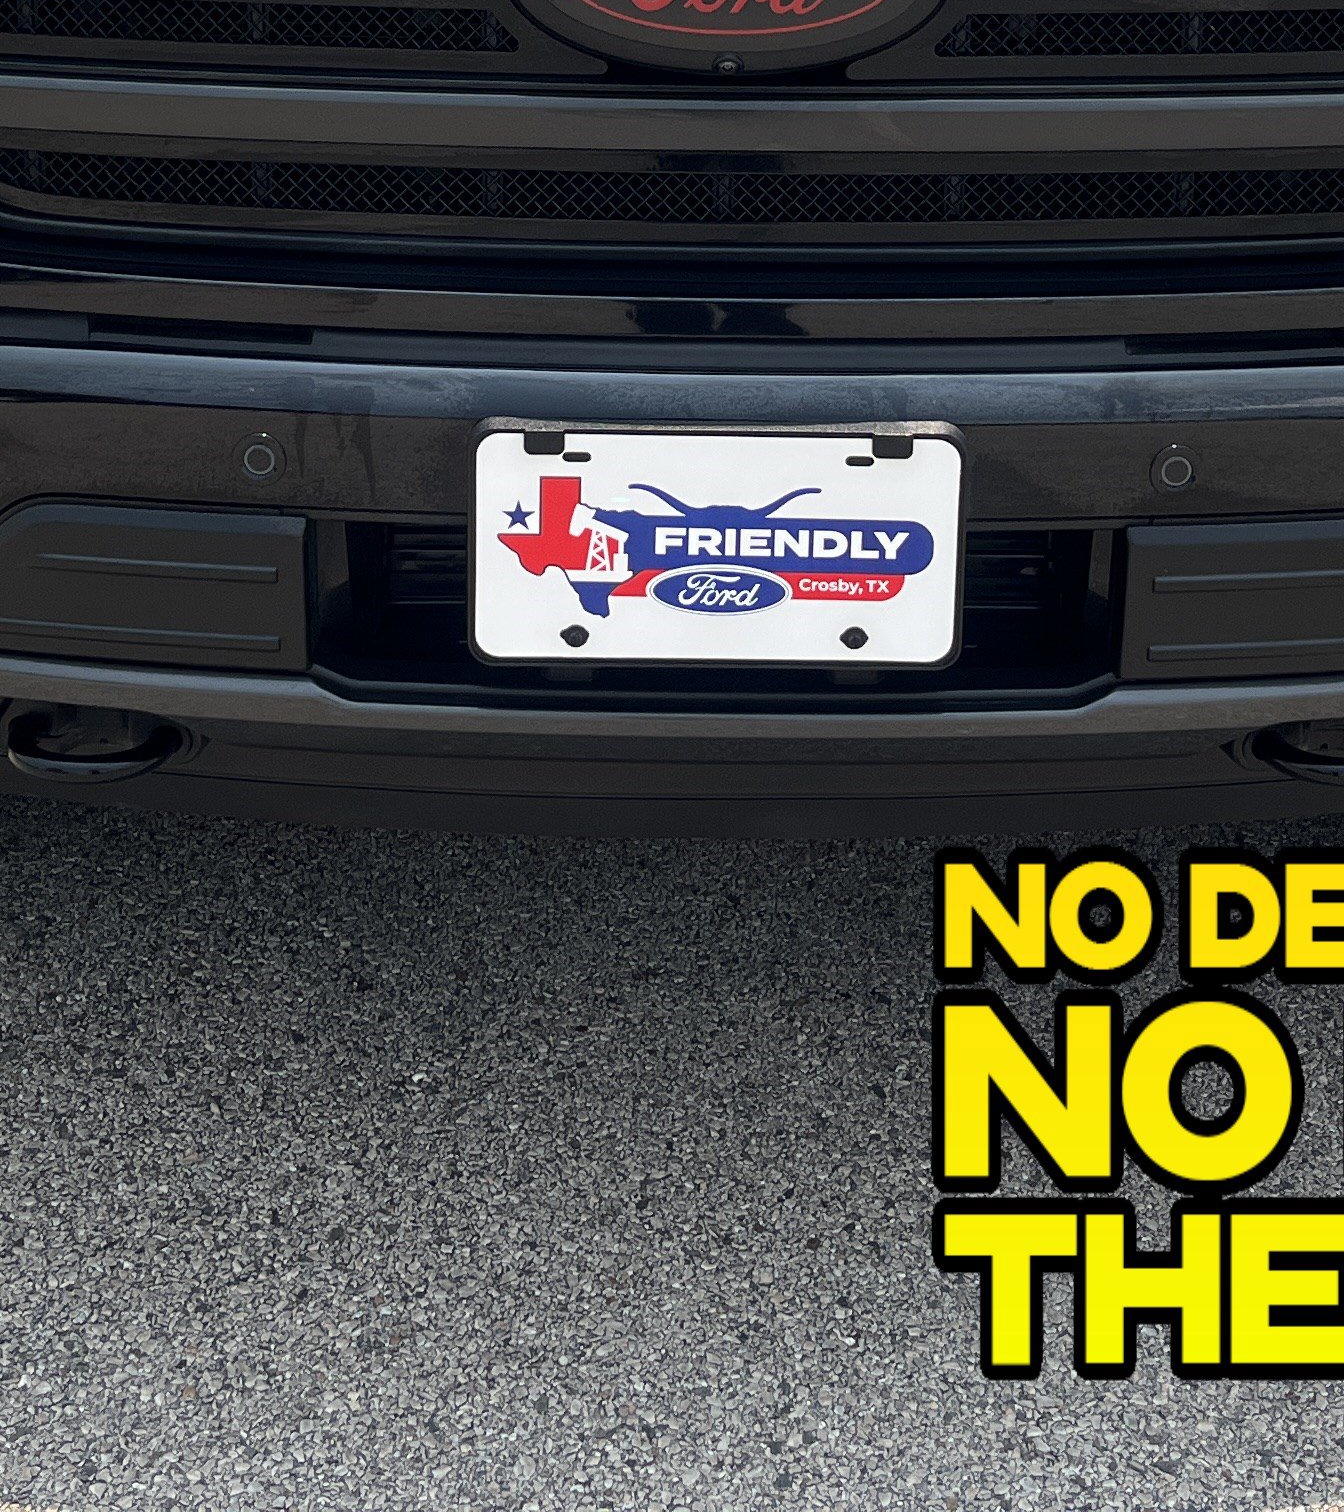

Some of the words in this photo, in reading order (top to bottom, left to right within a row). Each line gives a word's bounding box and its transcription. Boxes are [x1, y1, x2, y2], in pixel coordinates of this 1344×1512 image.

[654, 526, 910, 560] FRIENDLY
[677, 573, 761, 608] Ford
[798, 578, 864, 595] Crosby,
[865, 579, 890, 594] TX
